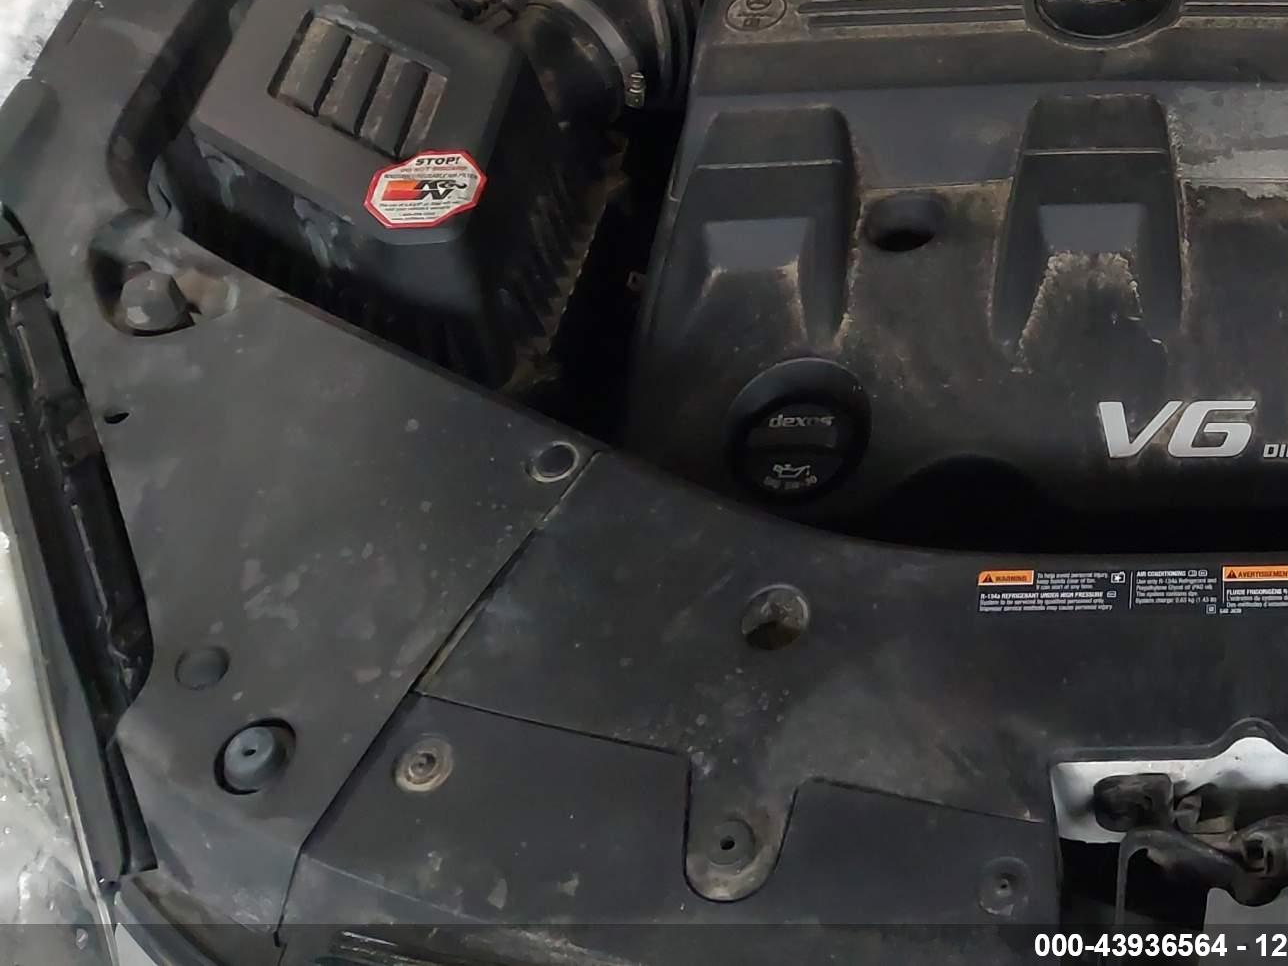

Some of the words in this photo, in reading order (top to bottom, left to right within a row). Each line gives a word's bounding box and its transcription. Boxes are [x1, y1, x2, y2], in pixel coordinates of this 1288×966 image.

[416, 156, 461, 166] STOP!
[769, 414, 835, 428] dexos
[1098, 400, 1257, 458] V6
[995, 575, 1028, 583] WARNING
